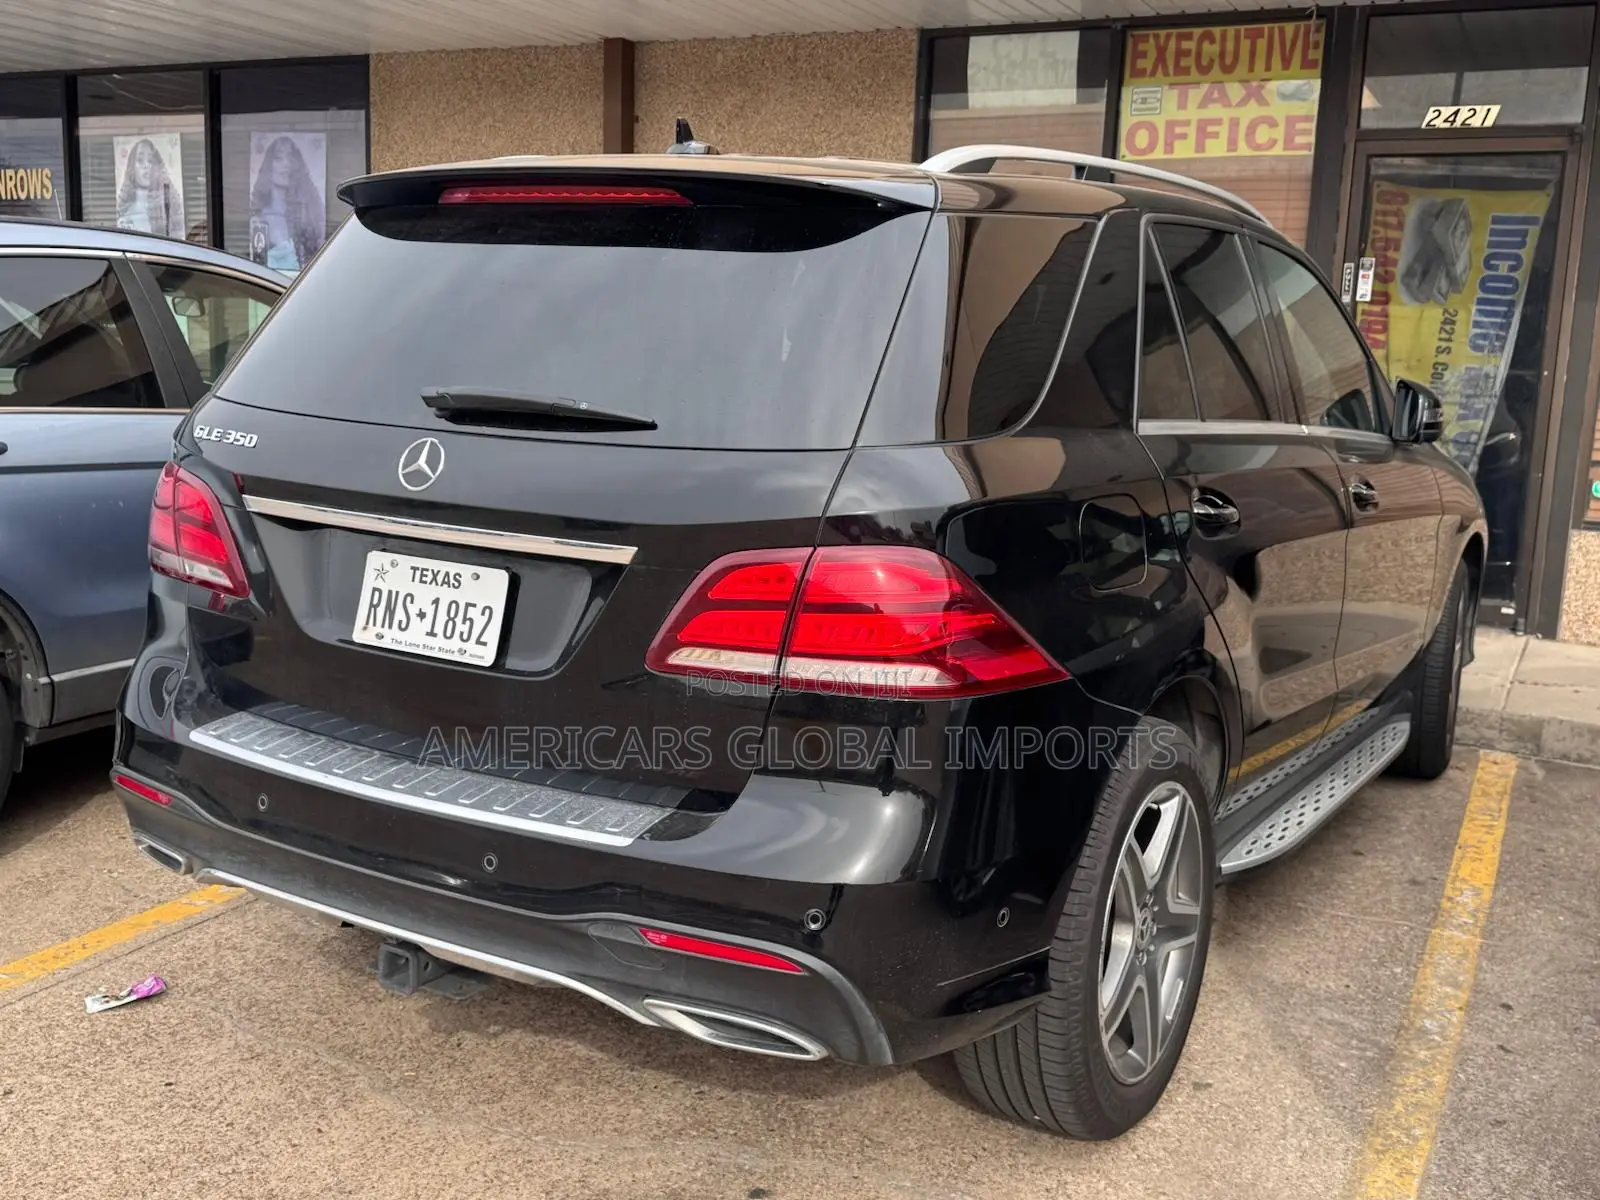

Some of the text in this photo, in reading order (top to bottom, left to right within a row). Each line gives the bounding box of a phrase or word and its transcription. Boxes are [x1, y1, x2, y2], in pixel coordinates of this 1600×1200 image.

[1129, 22, 1324, 78] EXECUTIVE
[1168, 79, 1272, 111] TAX
[1425, 107, 1492, 128] 2421
[1125, 115, 1315, 156] OFFICE
[1438, 307, 1458, 343] 2421
[193, 424, 259, 448] GLE 350
[409, 565, 462, 590] TEXAS
[365, 586, 493, 646] RNS 1852
[404, 640, 420, 649] Lone
[422, 643, 435, 651] Star
[438, 646, 455, 655] State
